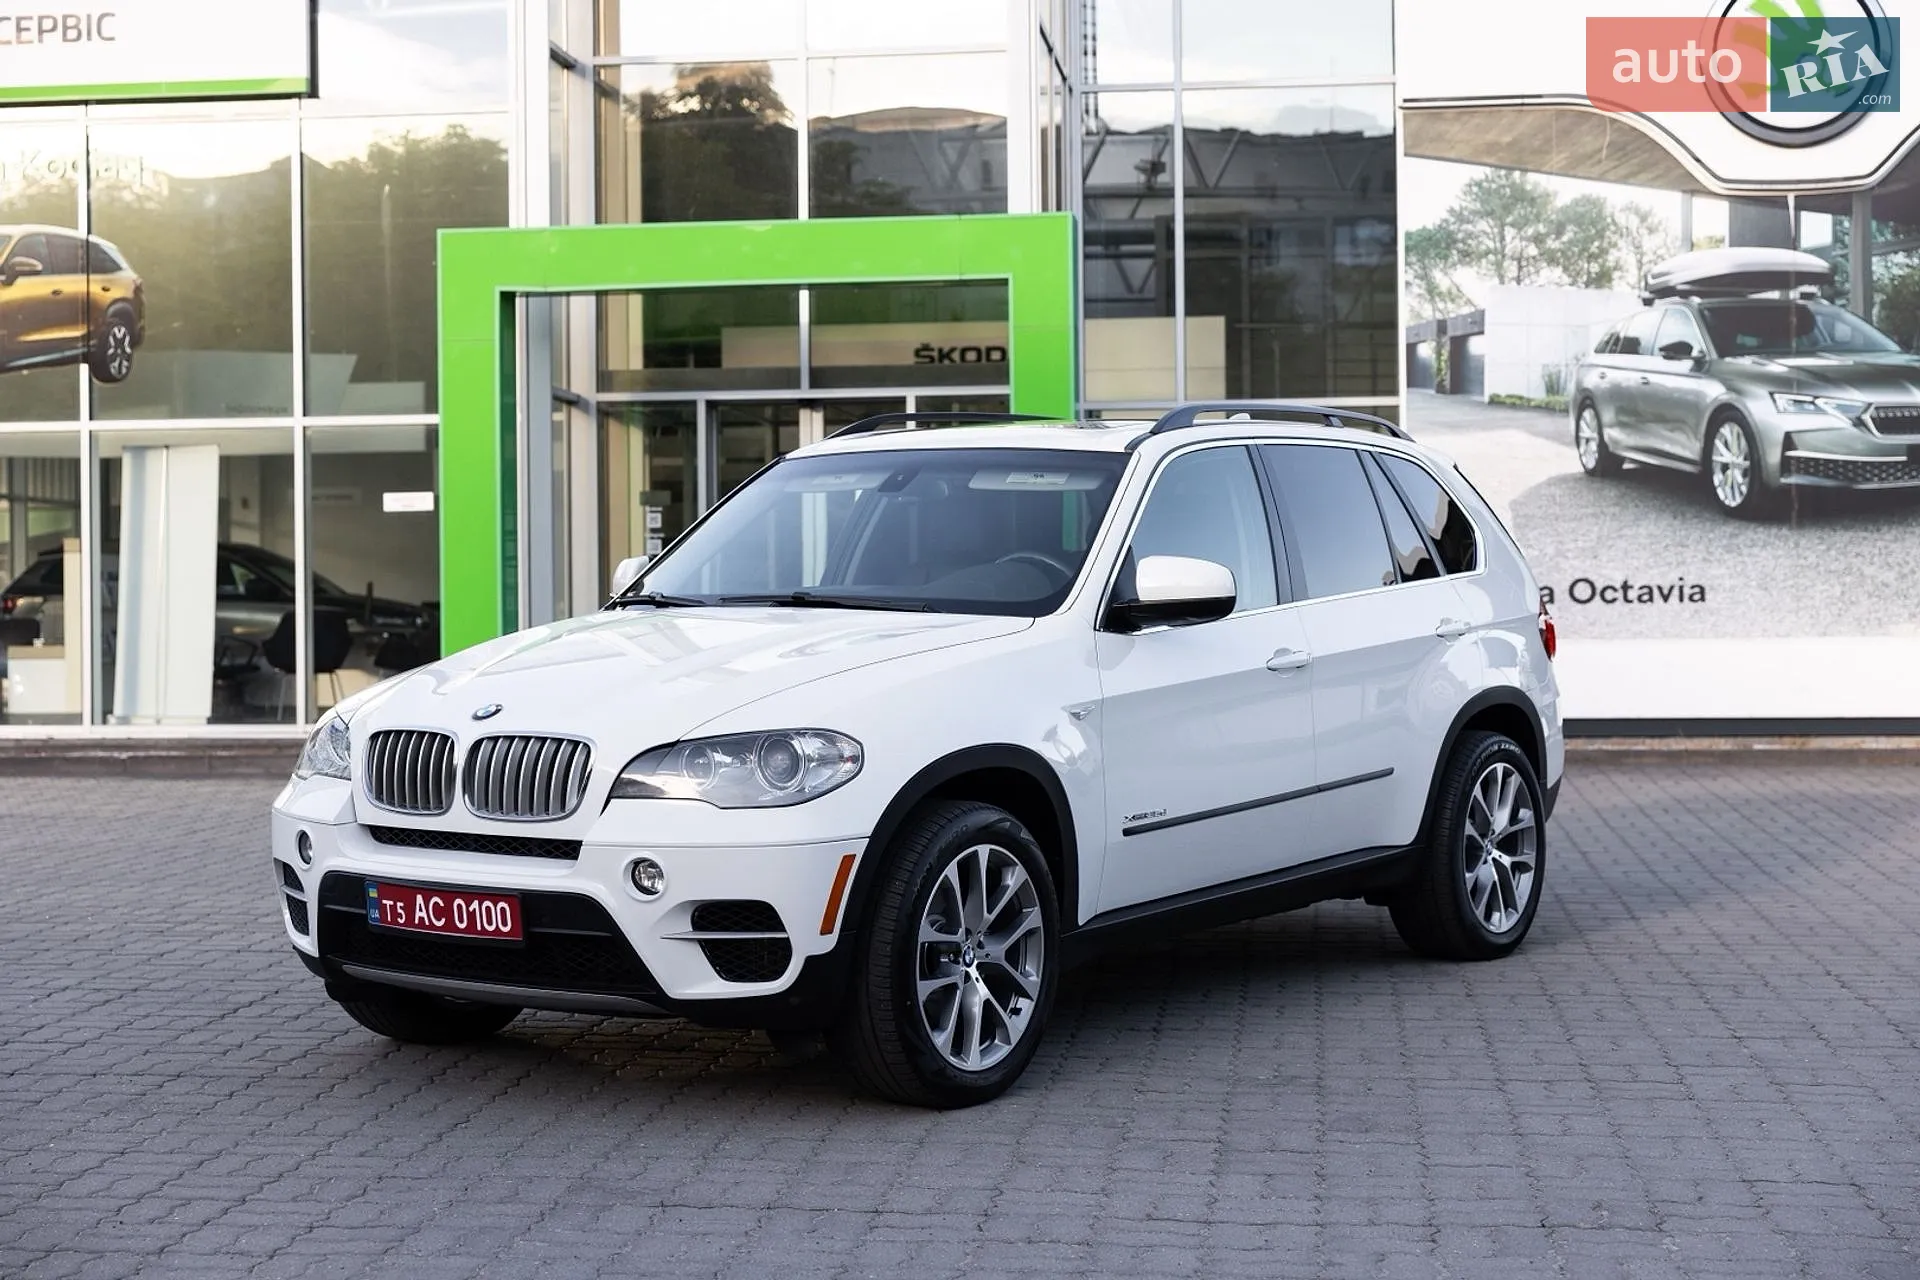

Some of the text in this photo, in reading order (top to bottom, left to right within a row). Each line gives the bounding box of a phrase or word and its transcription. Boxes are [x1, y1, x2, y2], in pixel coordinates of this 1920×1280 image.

[1568, 577, 1707, 604] Octavia
[414, 894, 446, 927] AC
[453, 898, 512, 933] 0100
